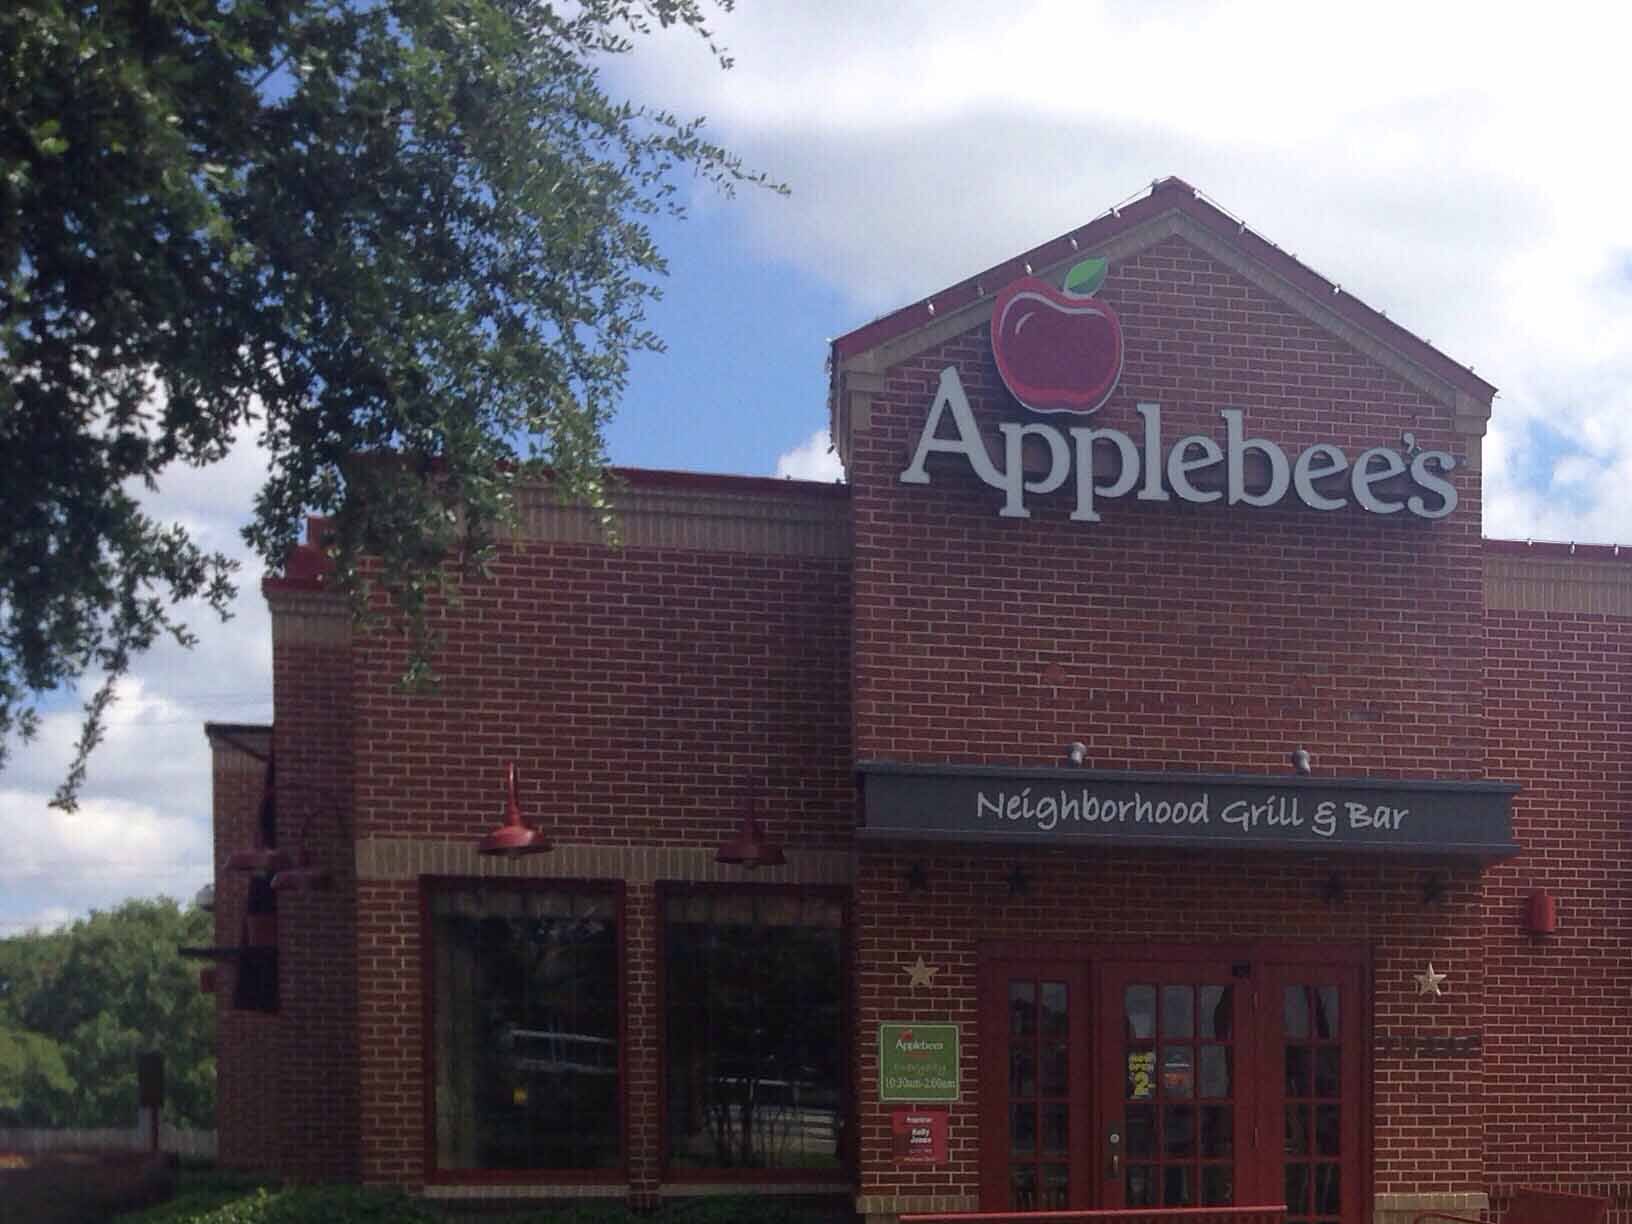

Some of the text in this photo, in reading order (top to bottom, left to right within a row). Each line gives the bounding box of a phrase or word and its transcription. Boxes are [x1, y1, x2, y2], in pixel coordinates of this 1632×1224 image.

[900, 366, 1459, 521] Applebee's
[976, 788, 1410, 836] Neighborhood Grill & Bar
